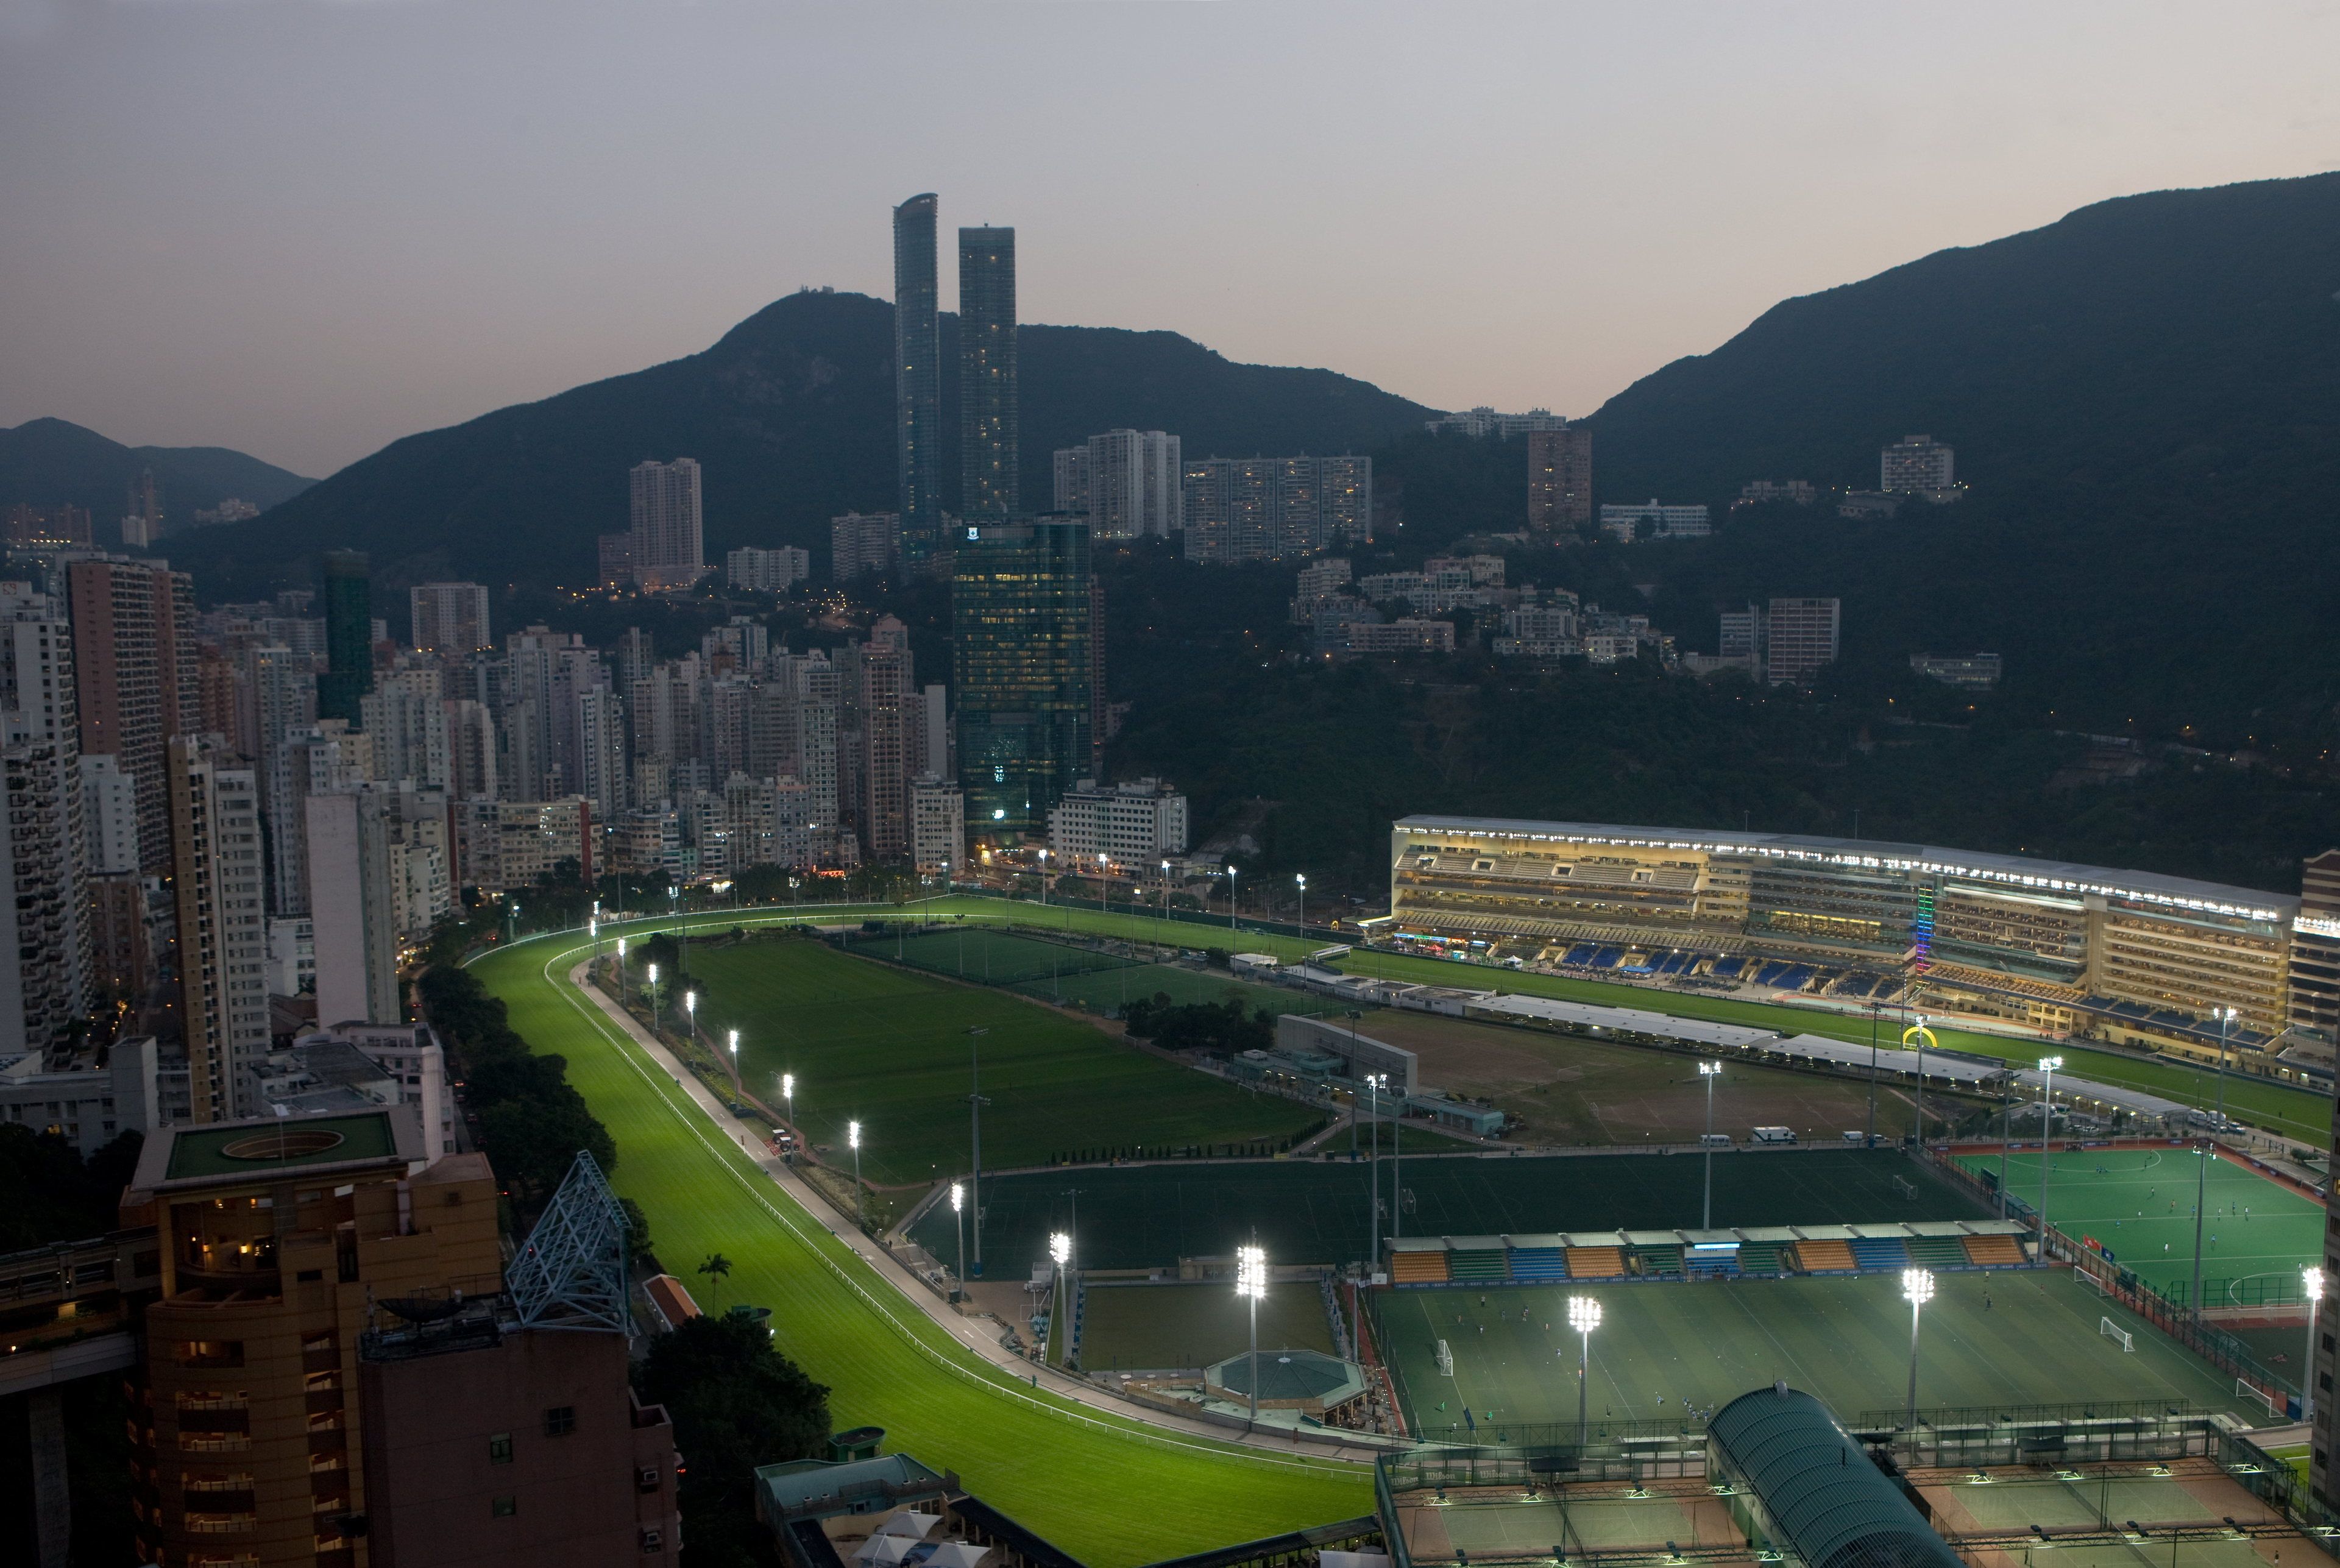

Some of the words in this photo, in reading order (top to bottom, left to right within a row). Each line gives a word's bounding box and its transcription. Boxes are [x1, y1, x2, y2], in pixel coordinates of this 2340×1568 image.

[1980, 1451, 2008, 1460] Wilson
[1480, 1470, 1509, 1478] Wilson
[1391, 1477, 1419, 1486] Wilson
